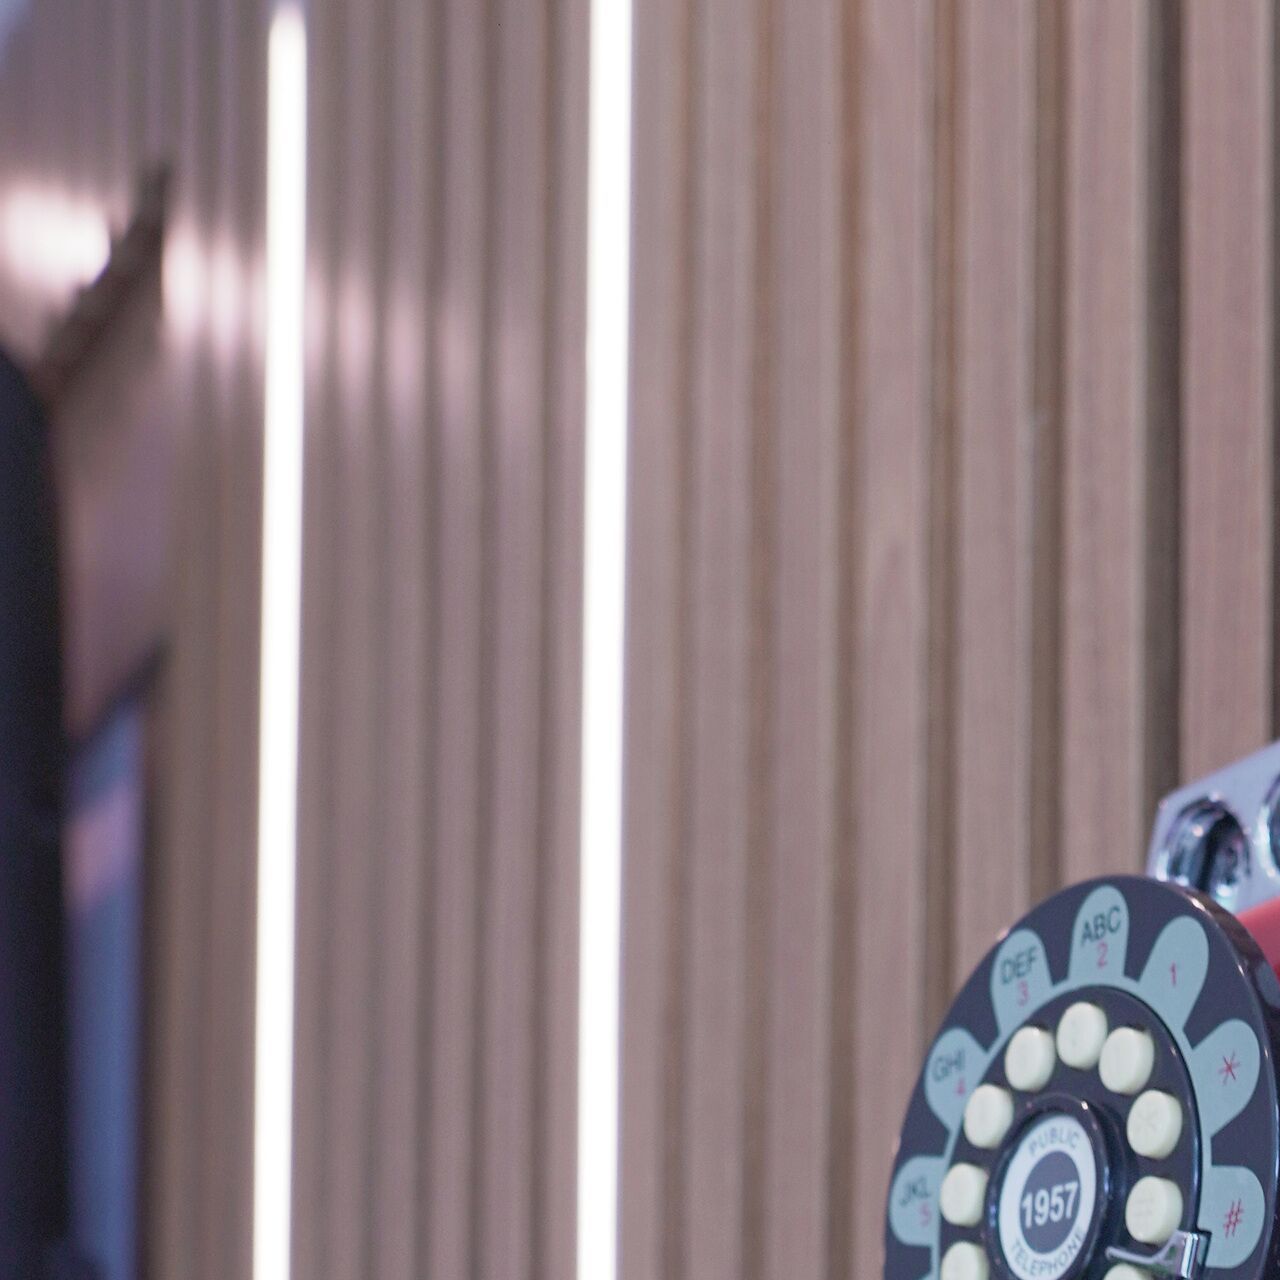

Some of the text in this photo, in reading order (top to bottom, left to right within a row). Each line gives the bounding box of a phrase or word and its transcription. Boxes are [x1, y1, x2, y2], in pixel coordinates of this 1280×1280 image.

[1081, 905, 1122, 946] ABC
[1001, 945, 1037, 986] DEF
[1098, 938, 1110, 971] 2
[1169, 960, 1178, 988] 1
[1017, 980, 1030, 1007] 3
[932, 1050, 966, 1083] GHI
[1028, 1126, 1081, 1158] PUBLIC
[1020, 1180, 1080, 1230] 1957
[1011, 1225, 1086, 1277] TELEPHONE
